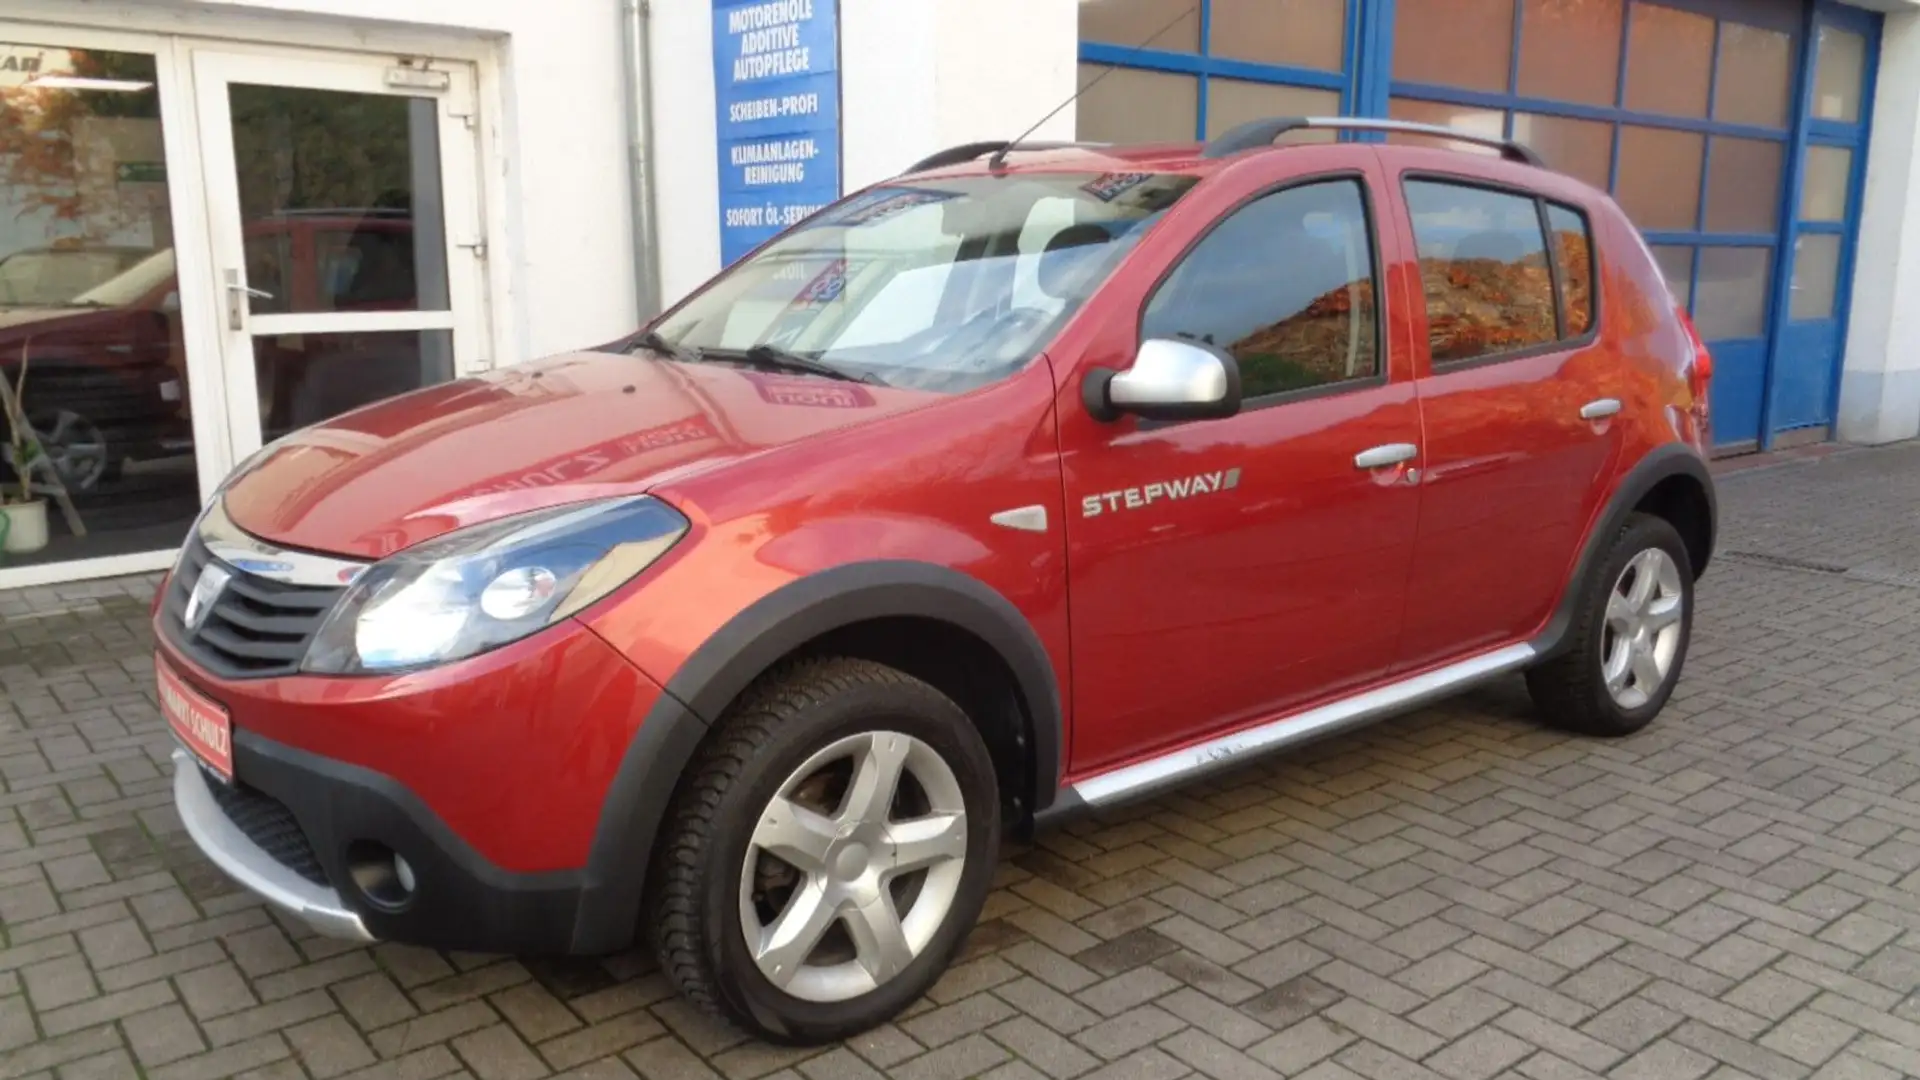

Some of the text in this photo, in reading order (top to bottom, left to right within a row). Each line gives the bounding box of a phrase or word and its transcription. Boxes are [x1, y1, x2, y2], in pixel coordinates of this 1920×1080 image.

[741, 23, 799, 55] ADDITIVE
[733, 47, 810, 82] AUTOPFLEGE
[729, 93, 818, 123] SCHEIBEN-PROFI
[731, 139, 820, 166] KLIMAANLAGEN-
[744, 163, 805, 185] REINIGUNG
[726, 207, 763, 227] SOFORT
[1082, 471, 1222, 518] STEPWAY
